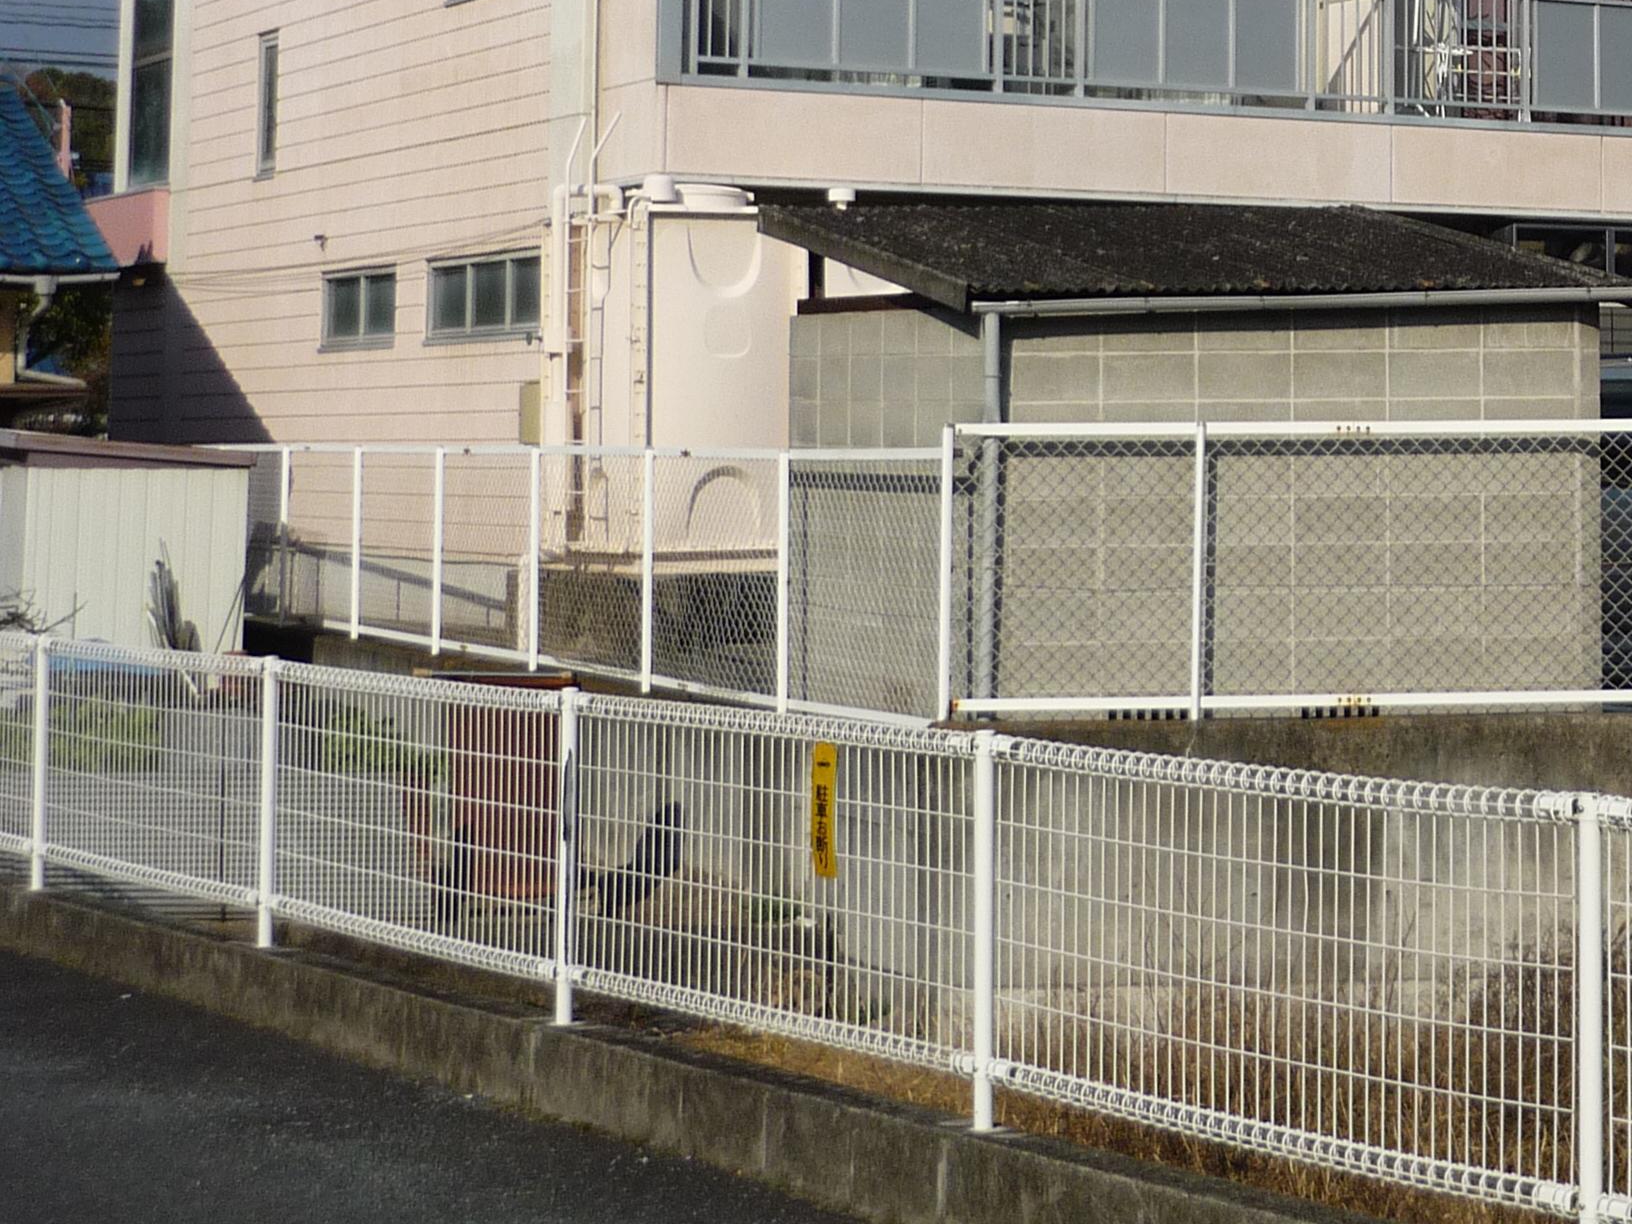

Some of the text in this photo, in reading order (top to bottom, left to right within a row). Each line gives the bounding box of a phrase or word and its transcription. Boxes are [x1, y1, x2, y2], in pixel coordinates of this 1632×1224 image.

[816, 783, 828, 870] 駐車お断り
